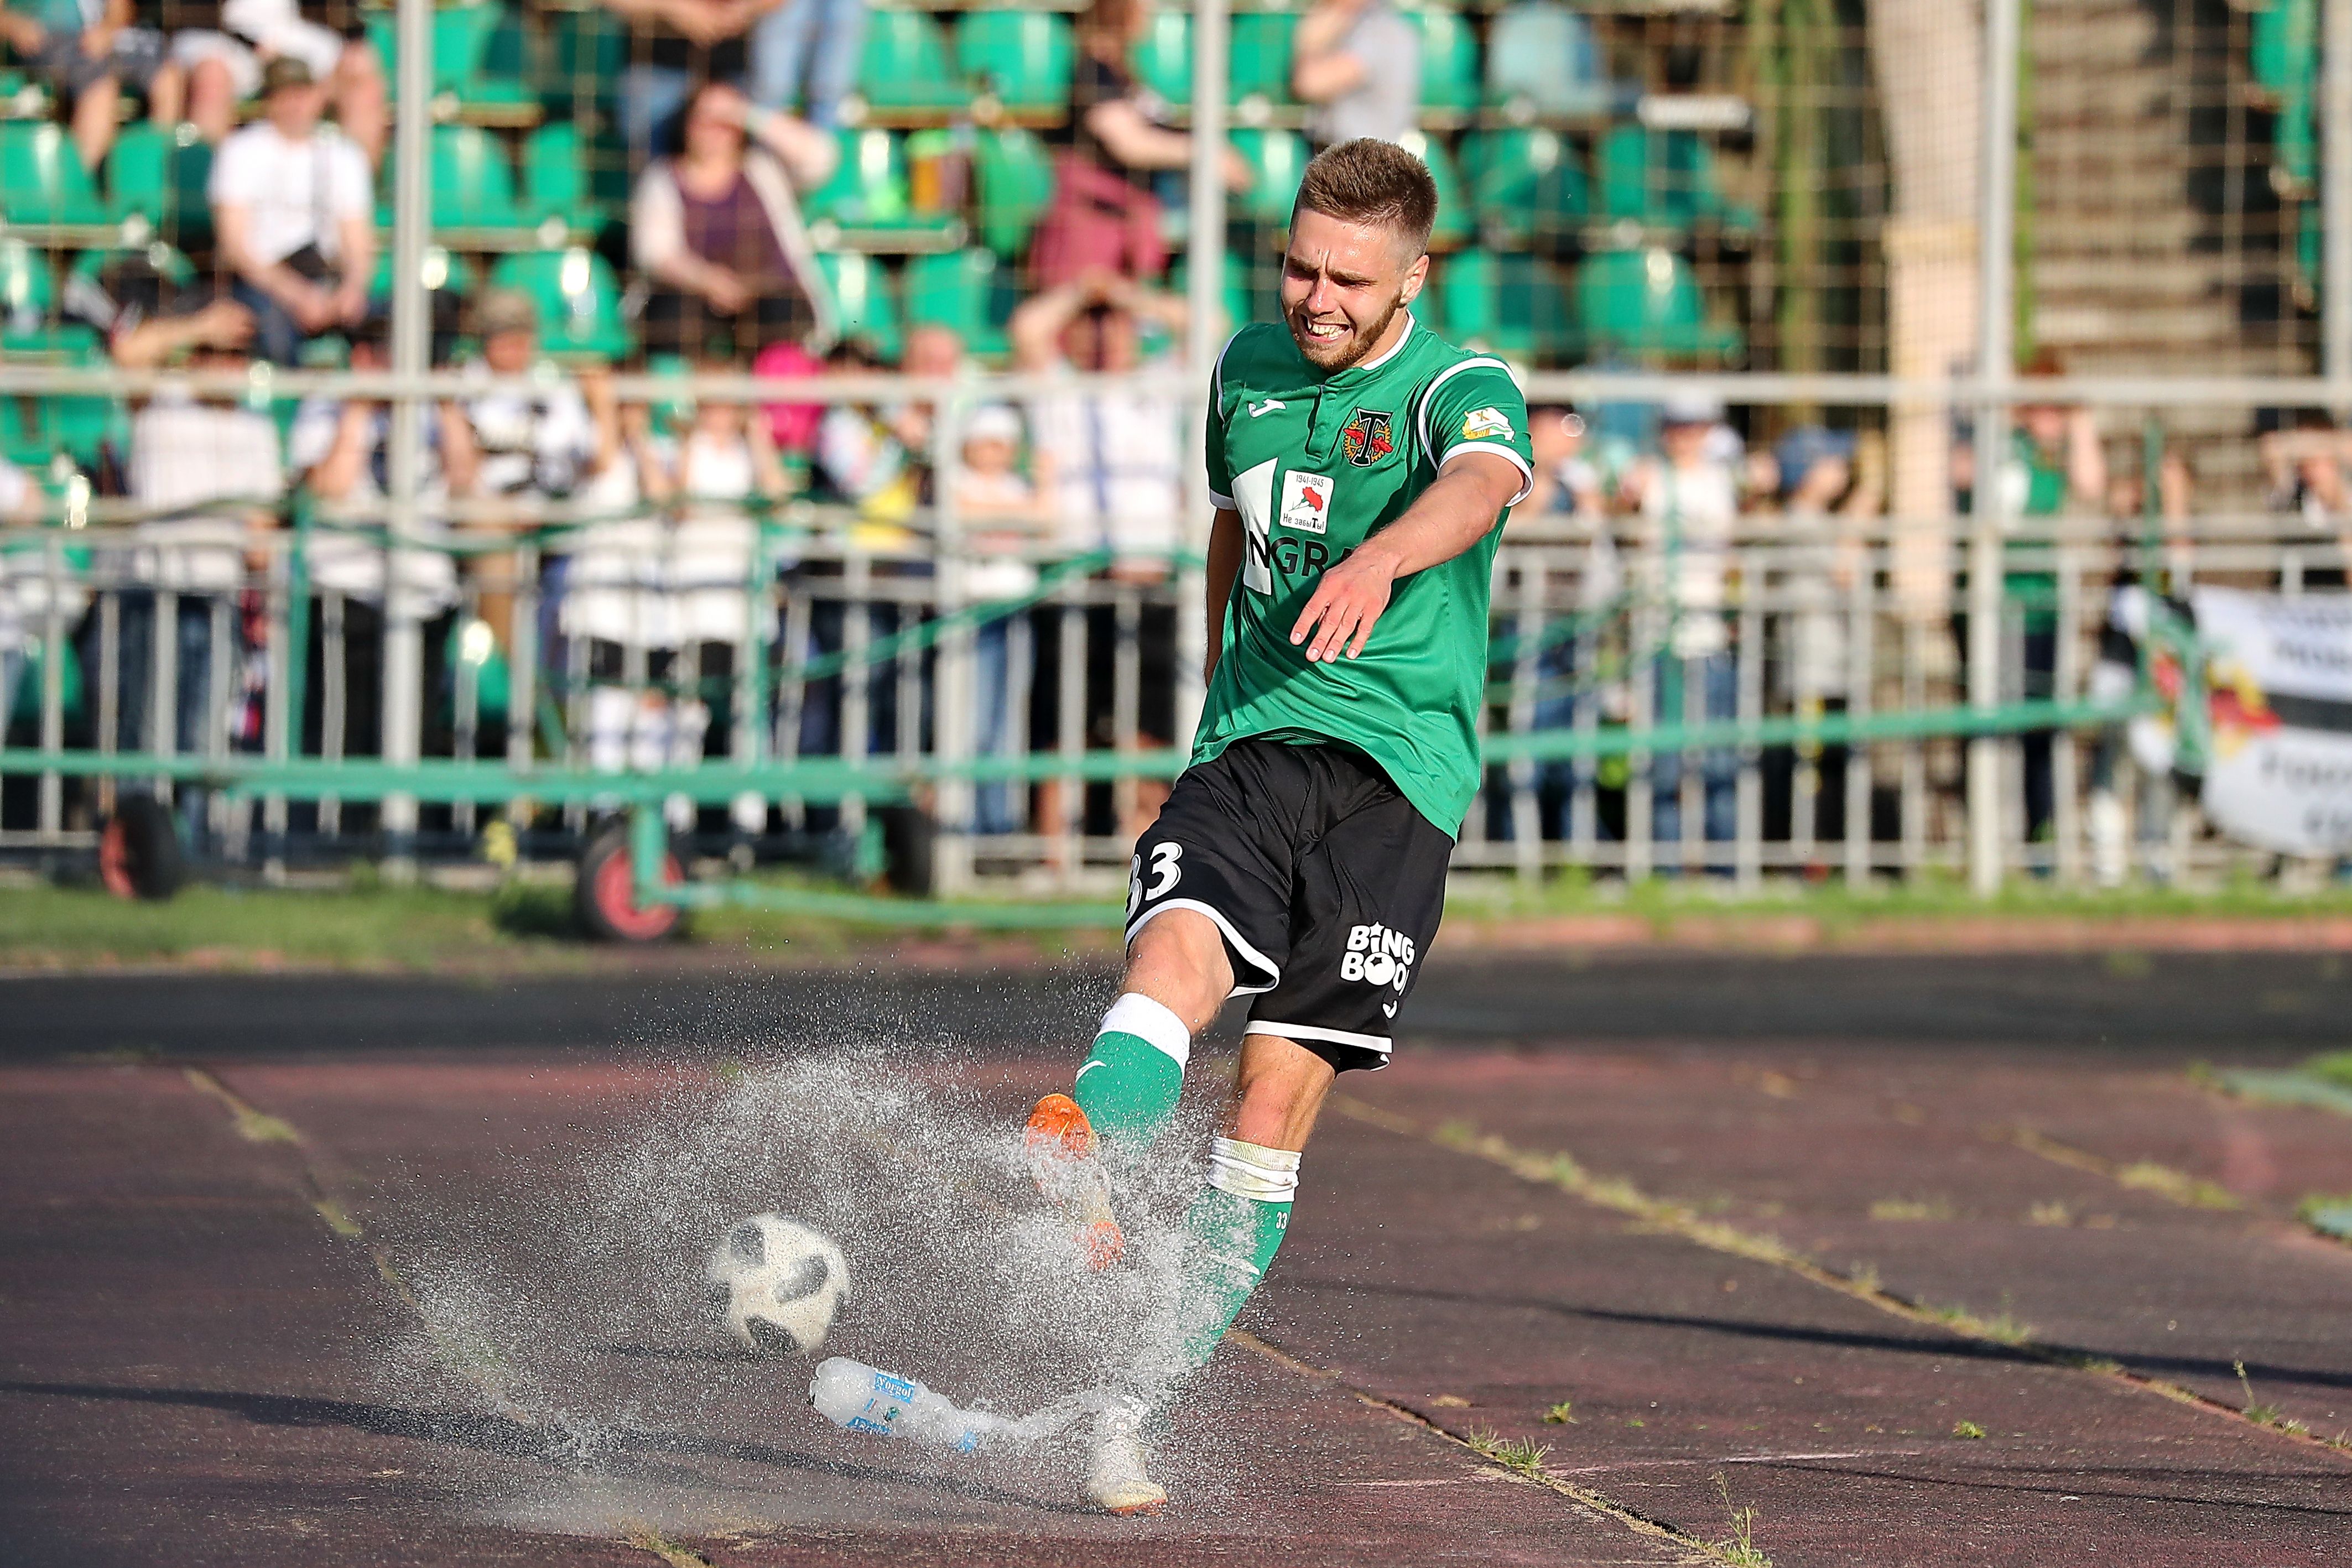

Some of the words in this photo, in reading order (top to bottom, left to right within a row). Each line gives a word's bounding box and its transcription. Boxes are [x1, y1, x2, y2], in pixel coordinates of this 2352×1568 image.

[1296, 474, 1324, 487] 1941-1945
[1283, 513, 1292, 524] Не
[1340, 951, 1410, 996] BOO
[1276, 1211, 1288, 1230] 33
